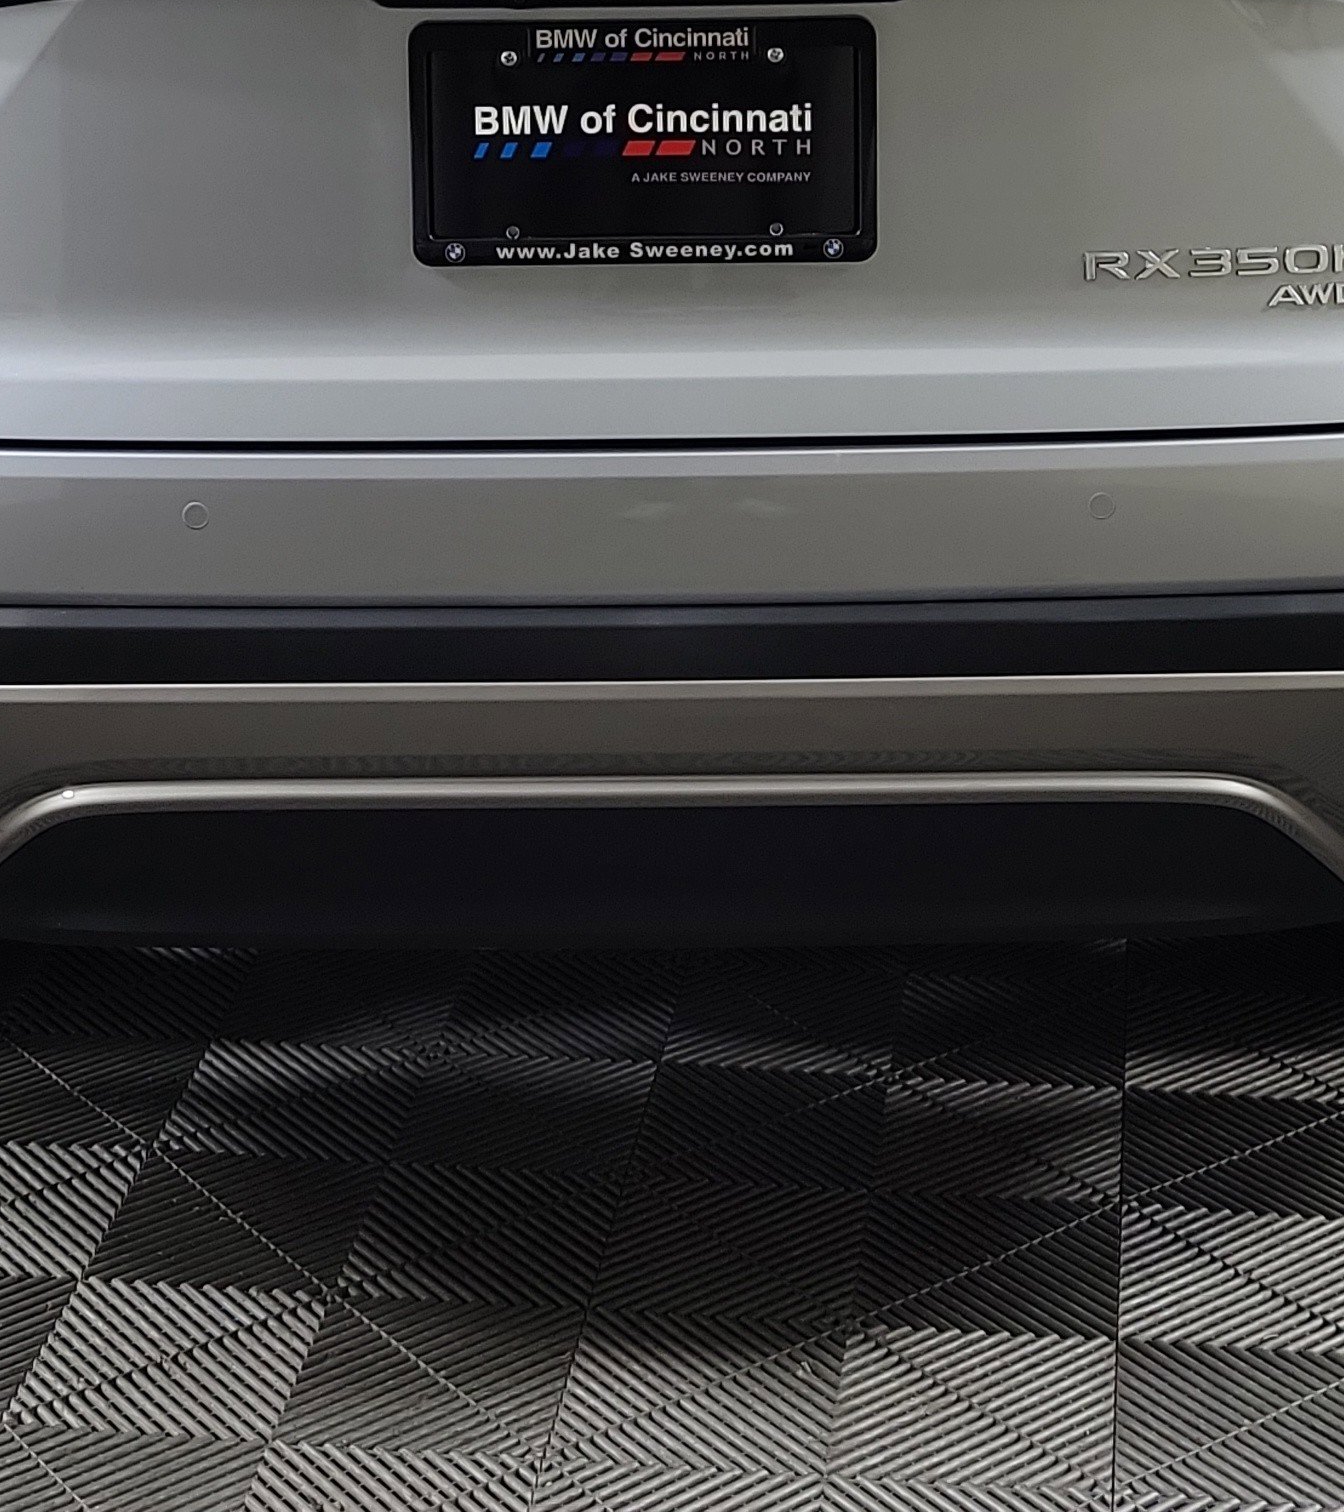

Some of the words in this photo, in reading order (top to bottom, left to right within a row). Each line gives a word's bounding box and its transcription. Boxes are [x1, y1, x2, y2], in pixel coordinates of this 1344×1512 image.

[535, 29, 597, 49] BMW
[604, 28, 628, 48] of
[634, 26, 749, 48] Cincinnati
[693, 51, 750, 61] NORTH
[474, 104, 569, 136] BMW
[580, 103, 617, 135] of
[627, 102, 813, 134] Cincinnati
[701, 138, 812, 156] NORTH
[631, 172, 641, 183] A
[643, 172, 677, 183] JAKE
[680, 172, 744, 182] SWEENEY
[747, 171, 812, 183] COMPANY
